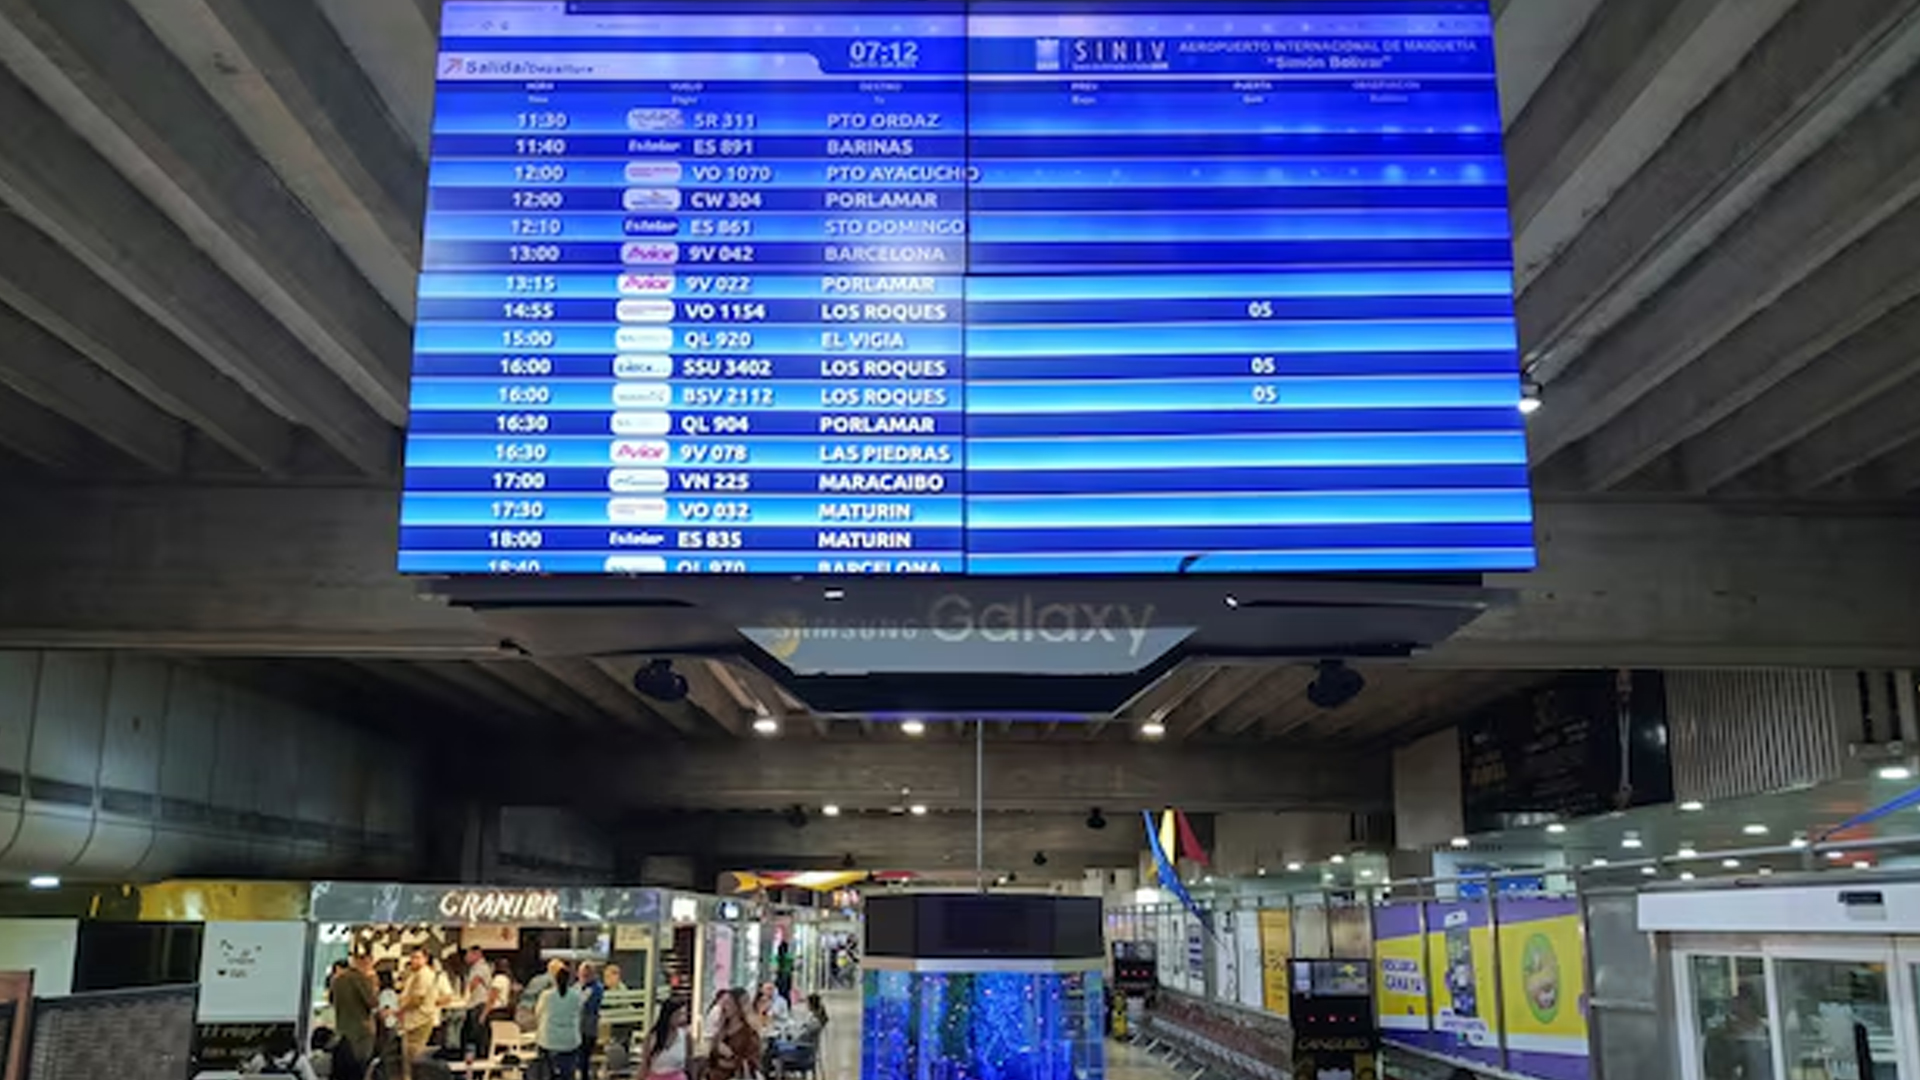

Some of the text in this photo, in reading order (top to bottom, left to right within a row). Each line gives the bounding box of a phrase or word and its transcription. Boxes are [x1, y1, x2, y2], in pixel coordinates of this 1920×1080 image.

[850, 42, 918, 61] 07:12
[1180, 41, 1270, 52] AEROPUERTO
[1274, 40, 1379, 51] INTERNACIONAL
[518, 113, 567, 128] 11:30
[722, 113, 756, 128] 311
[827, 113, 940, 128] PTO ORDAZ
[516, 139, 566, 154] 11:40
[693, 139, 716, 154] ES
[827, 139, 913, 154] BARINAS
[516, 166, 563, 180] 12:00
[692, 166, 721, 180] VO
[727, 166, 771, 180] 1070
[827, 166, 979, 180] PTO AYACUCHO
[513, 193, 563, 207] 12:00
[691, 193, 761, 207] CW 304
[825, 193, 937, 207] PORLAMAR
[511, 220, 561, 234] 12:10
[690, 220, 714, 234] ES
[825, 220, 966, 234] STO DOMINGO
[509, 246, 560, 261] 13:00
[688, 246, 754, 261] 9V 042
[825, 246, 945, 261] BARCELONA
[506, 276, 555, 291] 13:15
[686, 276, 750, 291] 9V 022
[821, 276, 934, 291] PORLAMAR
[504, 303, 553, 319] 14:55
[685, 303, 715, 319] VO
[721, 303, 765, 319] 1154
[821, 303, 946, 321] LOS ROQUES
[1248, 301, 1273, 317] 05
[502, 331, 552, 345] 15:00
[684, 331, 711, 347] QL
[716, 331, 751, 347] 920
[821, 331, 903, 347] EL VIGIA
[501, 359, 551, 375] 16:00
[683, 359, 721, 375] SSU
[724, 359, 772, 375] 3402
[821, 359, 946, 378] LOS ROQUES
[1251, 357, 1275, 374] 05
[500, 388, 549, 403] 16:00
[683, 388, 722, 403] BSV
[727, 388, 773, 403] 2112
[821, 388, 947, 406] LOS ROQUES
[1253, 385, 1277, 402] 05
[498, 416, 548, 432] 16:30
[682, 416, 749, 434] QL 904
[820, 416, 935, 432] PORLAMAR
[496, 445, 545, 461] 16:30
[680, 445, 747, 461] 9V 078
[820, 445, 951, 461] LAS PIEDRAS
[493, 473, 545, 490] 17:00
[679, 473, 710, 490] VN
[714, 473, 749, 490] 225
[818, 473, 945, 490] MARACAIBO
[491, 502, 543, 518] 17:30
[678, 502, 708, 518] VO
[714, 502, 748, 518] 032
[818, 502, 911, 518] MATURIN
[490, 532, 542, 547] 18:00
[678, 532, 742, 547] ES 835
[818, 532, 911, 547] MATURIN
[818, 560, 941, 573] BARCELONA
[930, 594, 1155, 656] Galaxy
